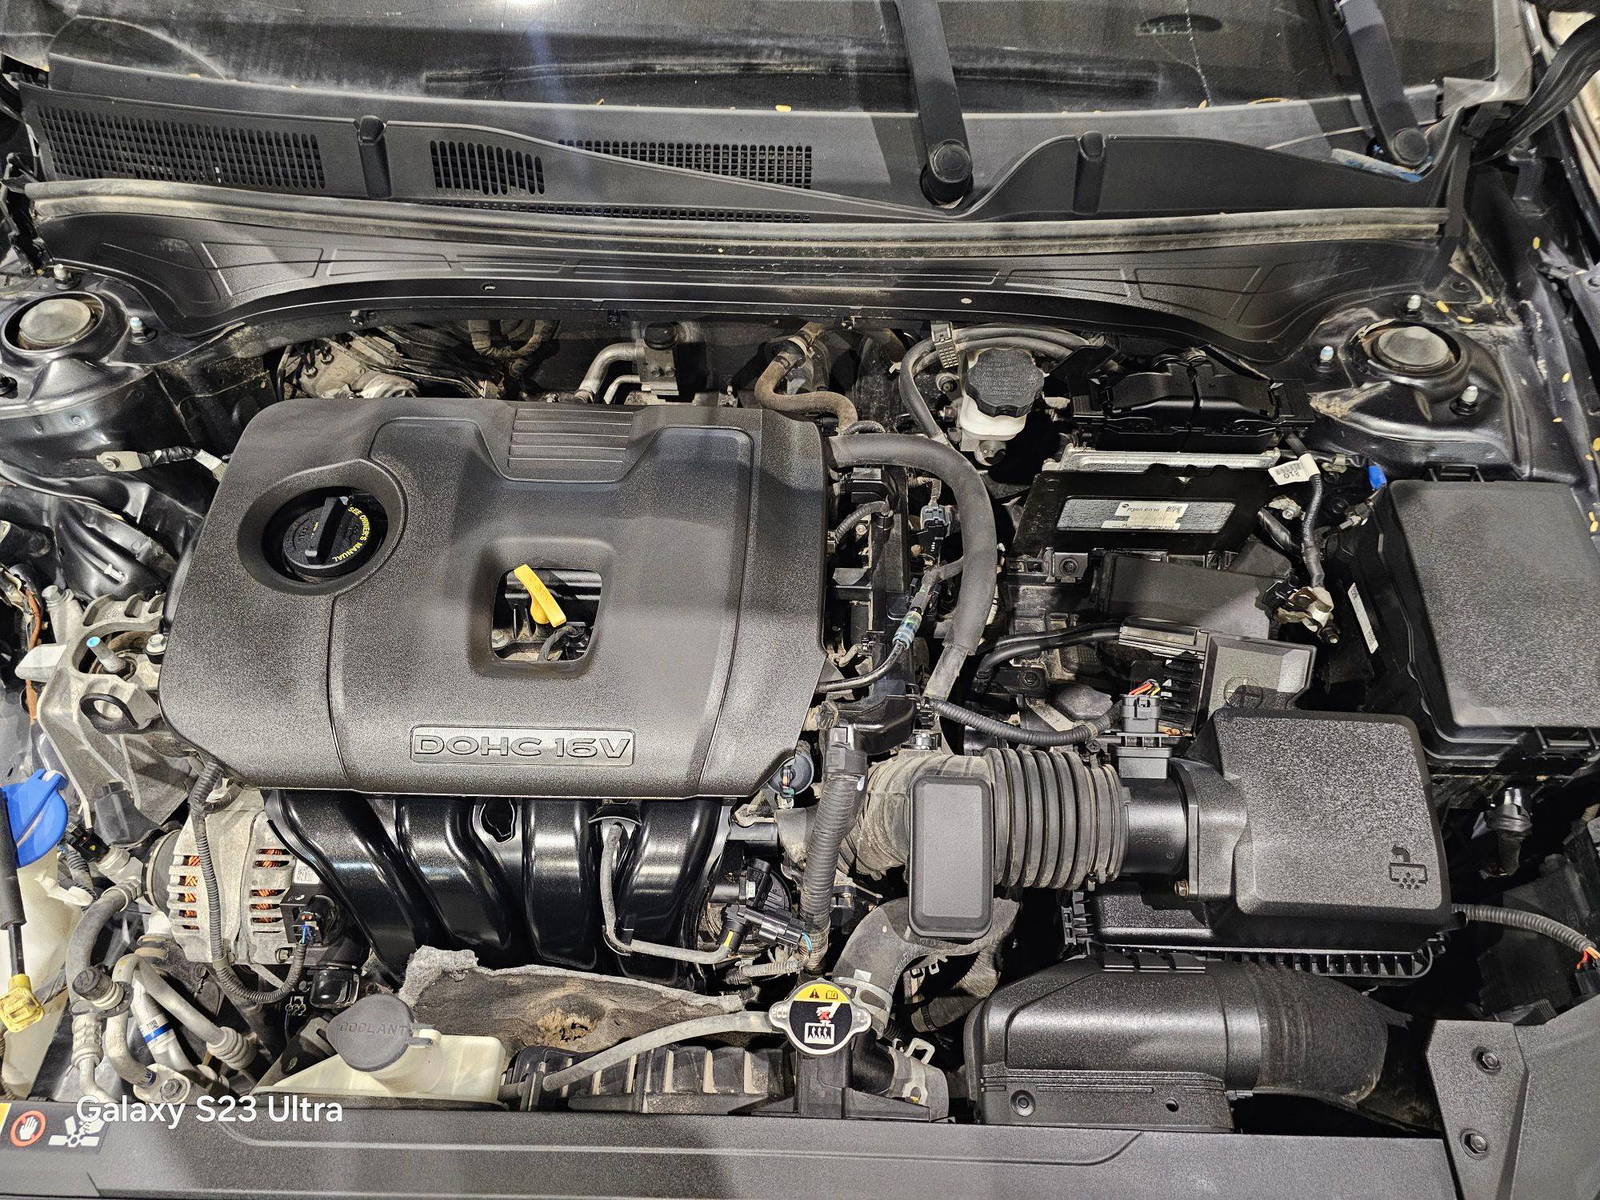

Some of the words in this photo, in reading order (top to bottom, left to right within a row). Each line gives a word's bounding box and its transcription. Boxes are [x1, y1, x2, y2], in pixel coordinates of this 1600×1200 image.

[348, 506, 362, 516] SEE
[332, 542, 363, 562] MANUAL
[414, 735, 542, 757] DOHC
[555, 737, 631, 758] 16V
